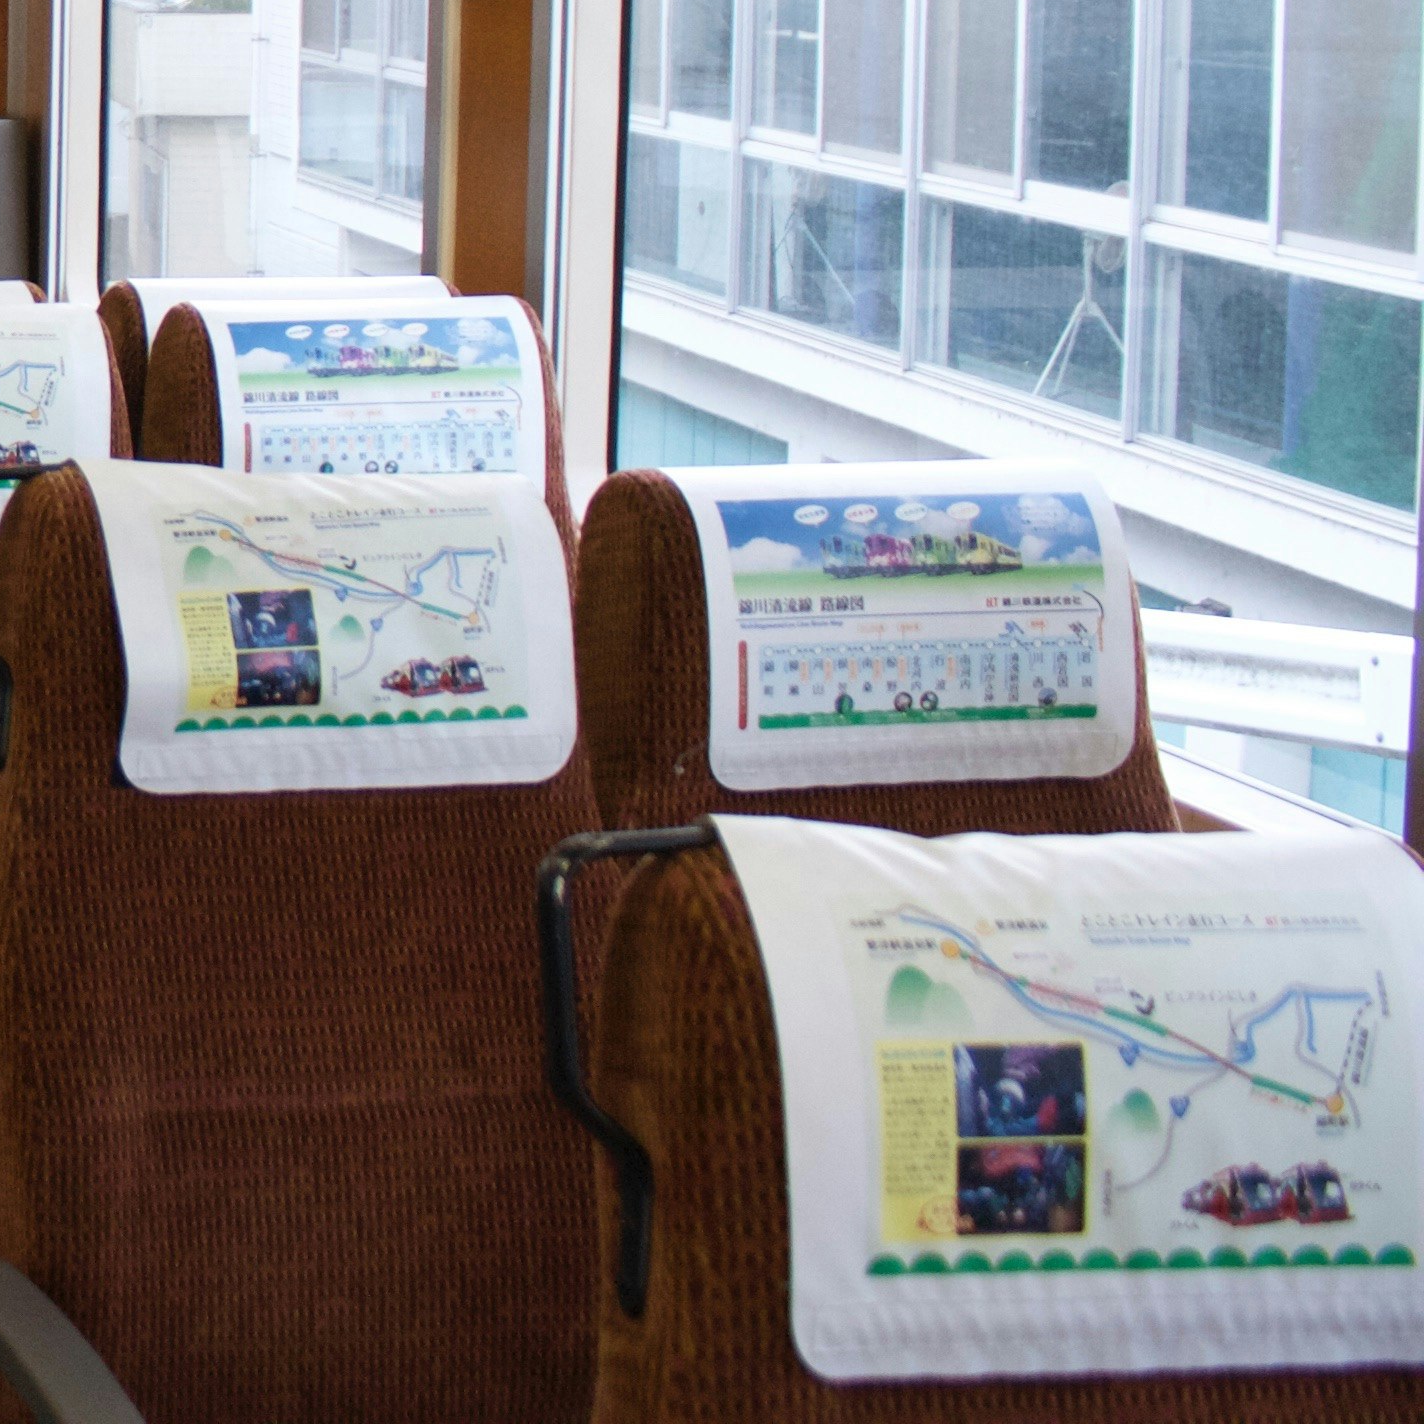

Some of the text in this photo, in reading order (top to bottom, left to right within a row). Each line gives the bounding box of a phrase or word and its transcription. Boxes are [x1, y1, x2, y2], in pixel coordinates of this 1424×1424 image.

[738, 595, 865, 616] 錦川清流線 路線図
